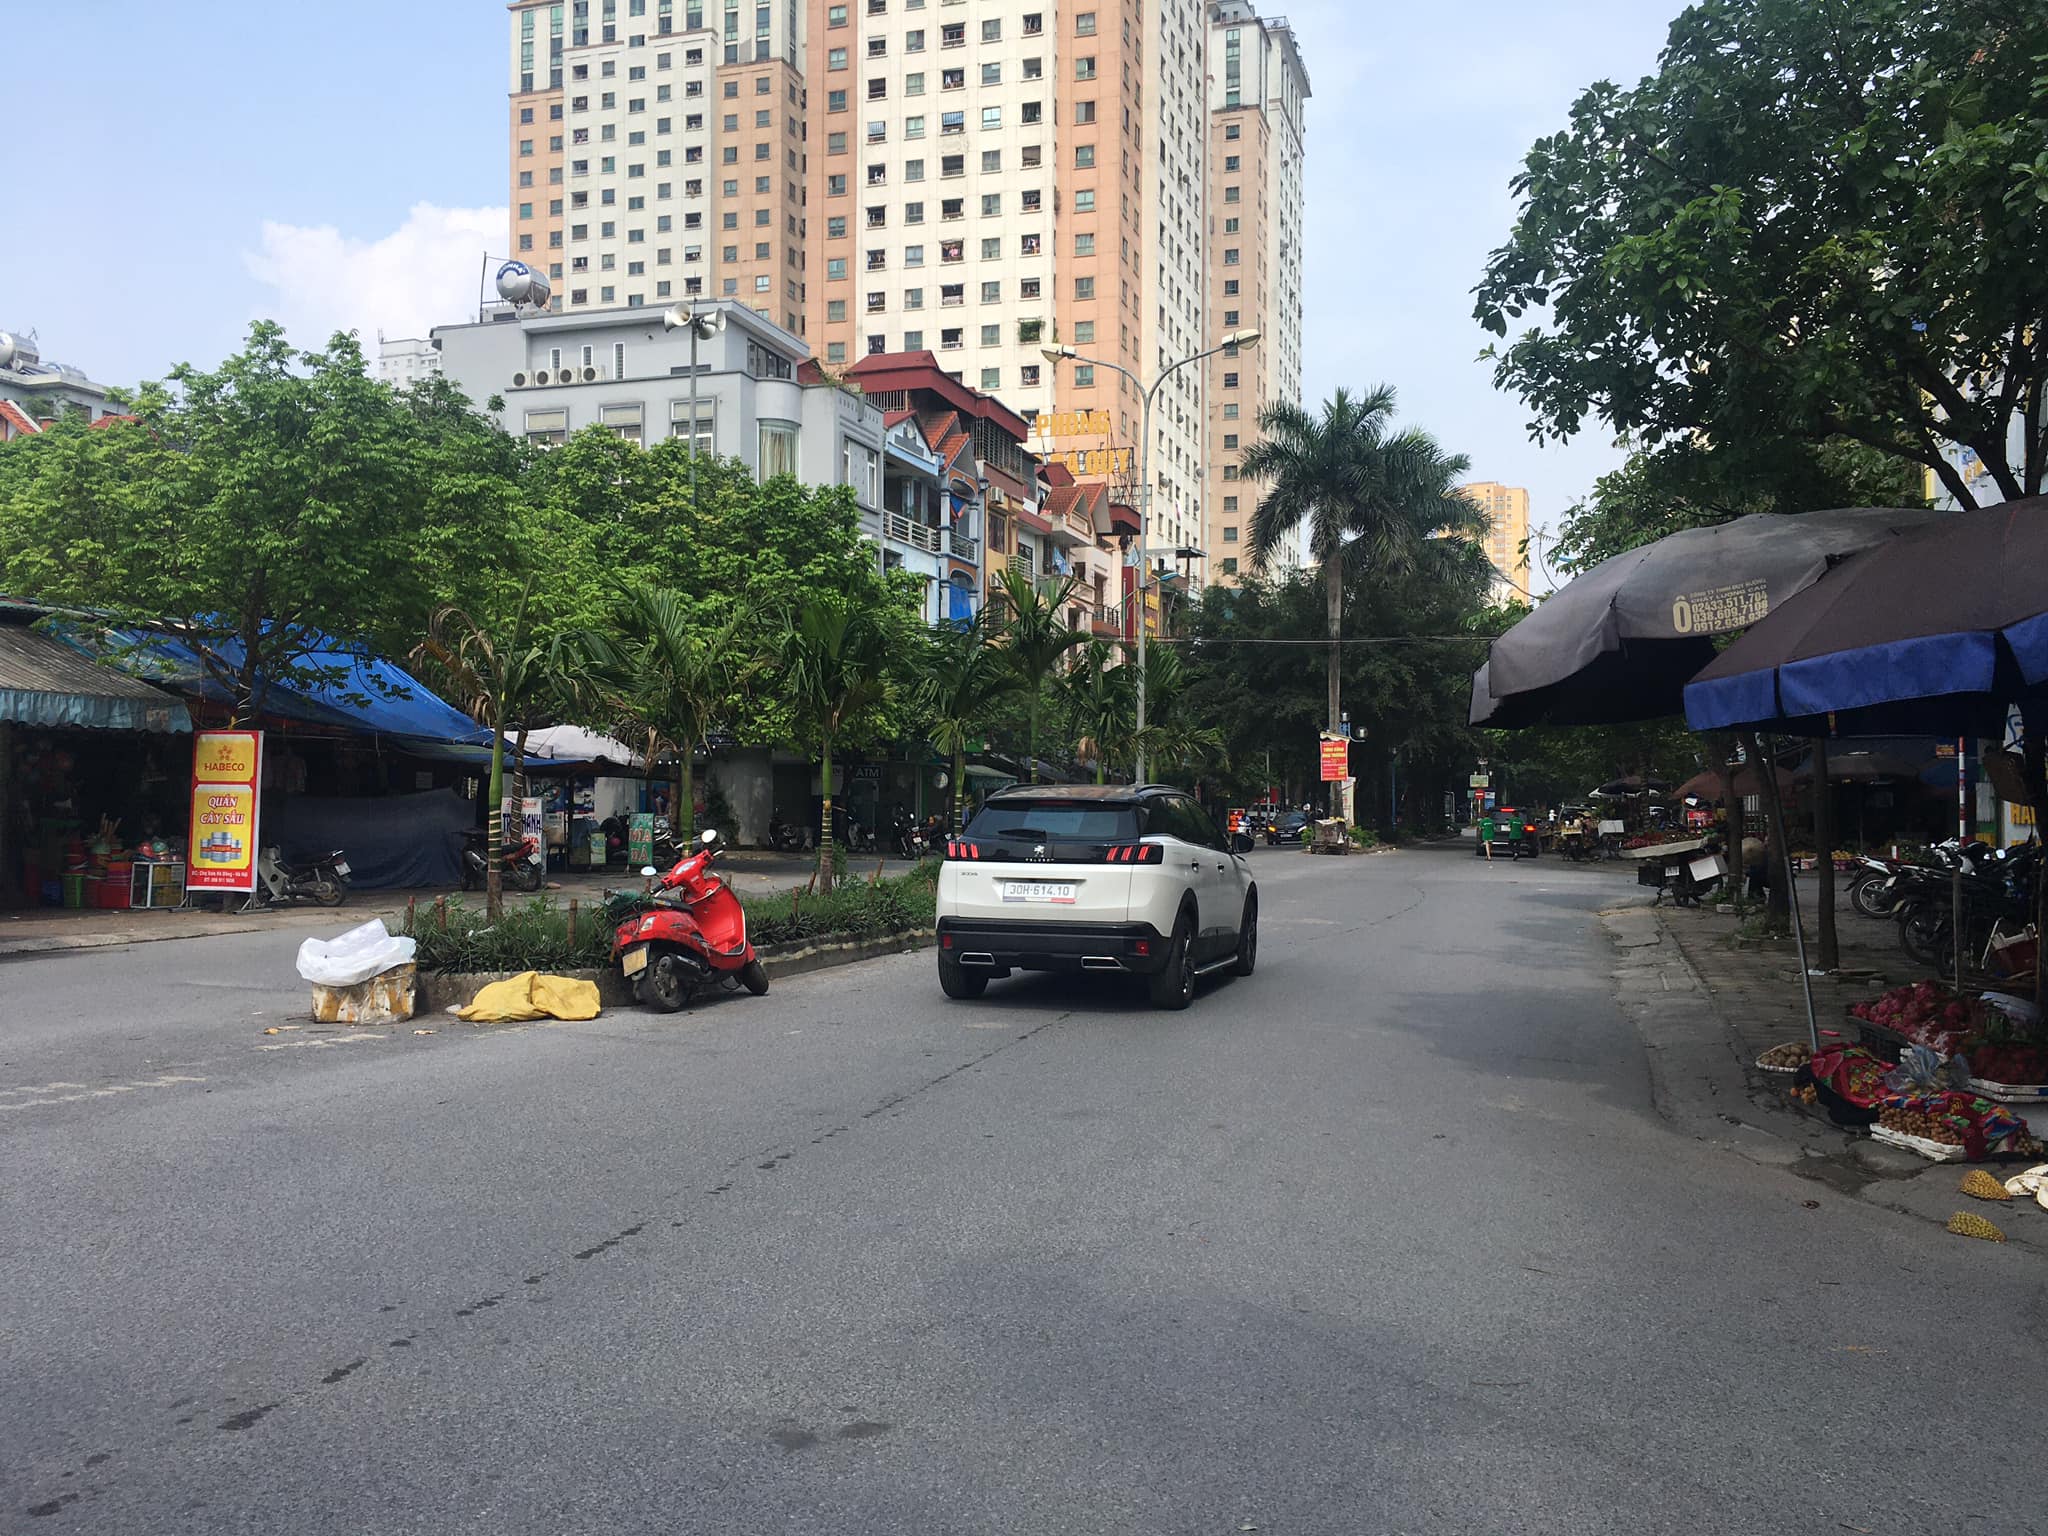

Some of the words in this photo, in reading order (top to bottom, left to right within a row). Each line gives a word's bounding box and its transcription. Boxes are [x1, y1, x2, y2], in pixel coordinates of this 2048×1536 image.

[1673, 595, 1692, 633] Ô
[204, 762, 245, 772] HABECO
[856, 767, 880, 777] ATM
